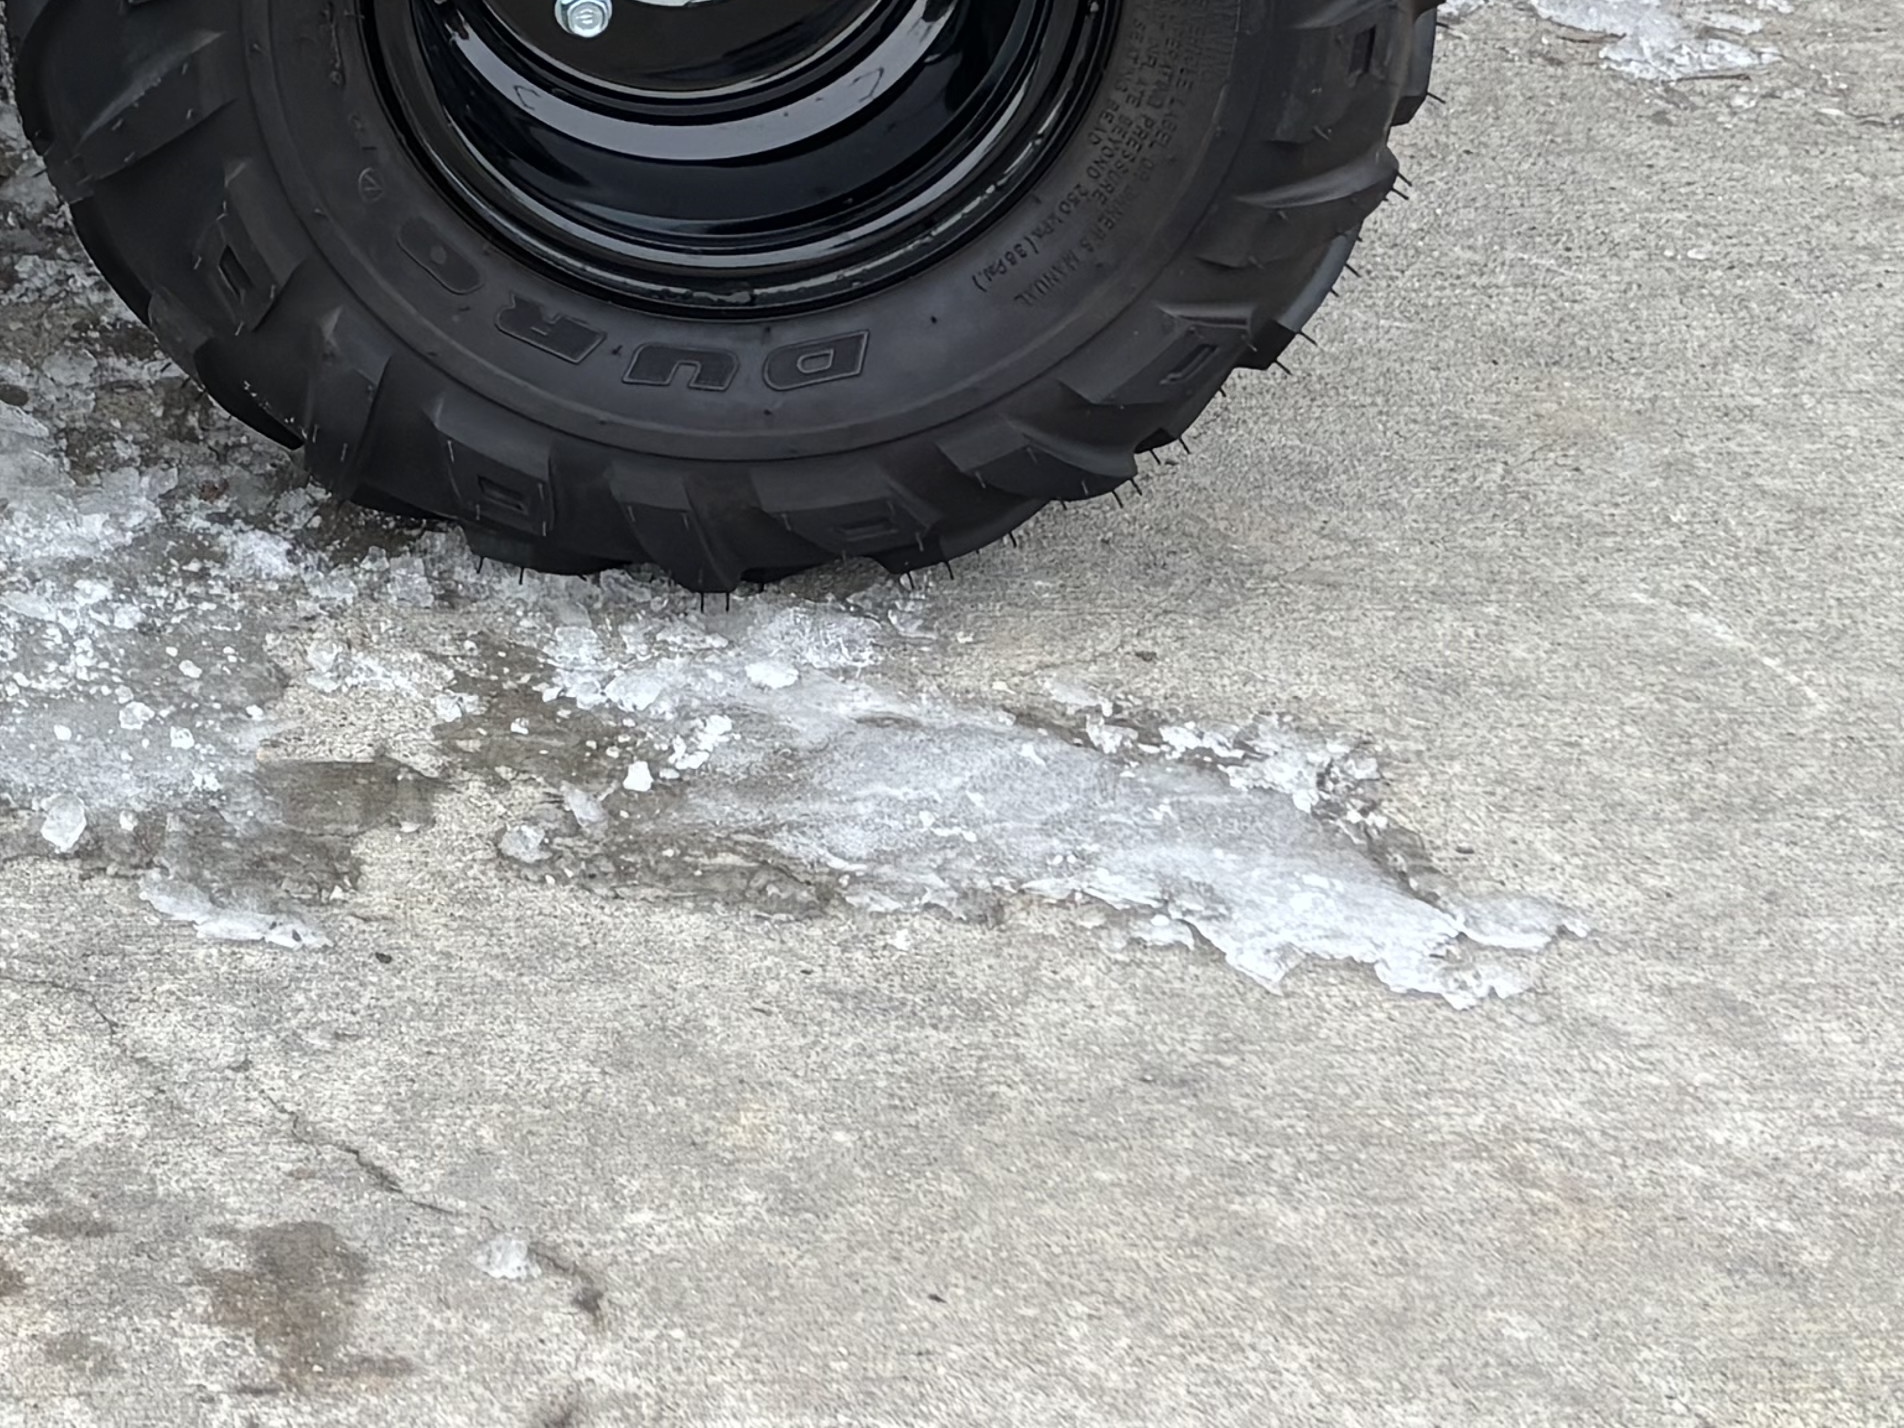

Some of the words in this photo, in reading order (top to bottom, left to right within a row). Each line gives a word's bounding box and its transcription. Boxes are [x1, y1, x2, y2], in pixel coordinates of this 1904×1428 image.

[1082, 114, 1134, 184] BEYOND
[1147, 95, 1186, 156] LABEL
[1058, 183, 1089, 215] 250
[396, 216, 870, 391] DURO
[1014, 249, 1080, 306] MANUAL
